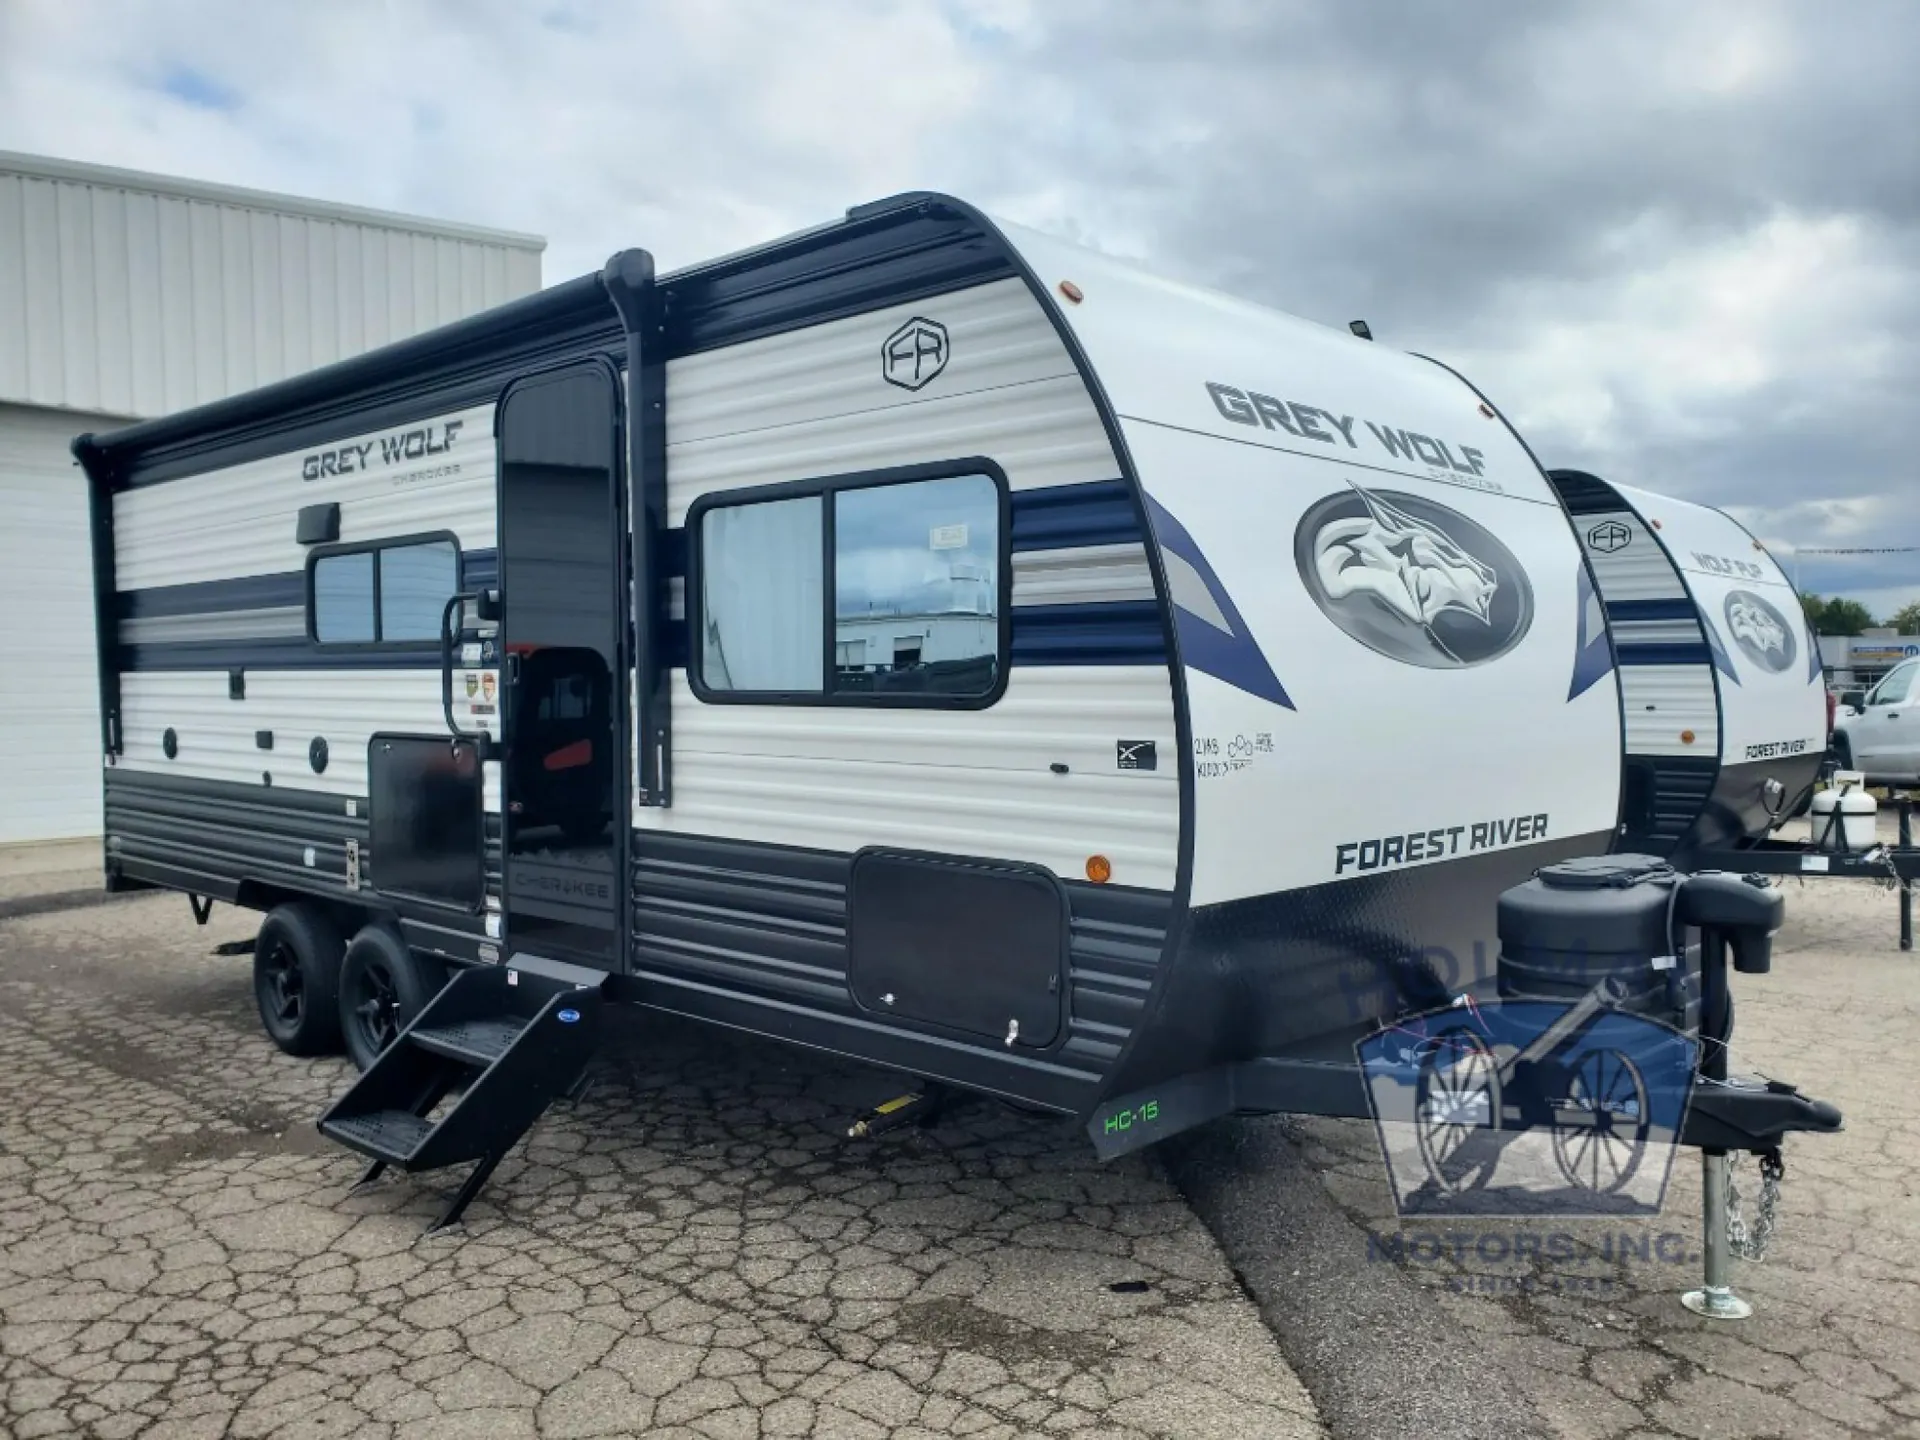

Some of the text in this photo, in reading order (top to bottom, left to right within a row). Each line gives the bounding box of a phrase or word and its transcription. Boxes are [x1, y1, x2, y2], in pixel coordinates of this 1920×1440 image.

[303, 420, 464, 482] GREY WOLF
[1205, 381, 1485, 476] GREY WOLF
[1745, 739, 1806, 759] FOREST RIVER
[1335, 813, 1548, 875] FOREST RIVER
